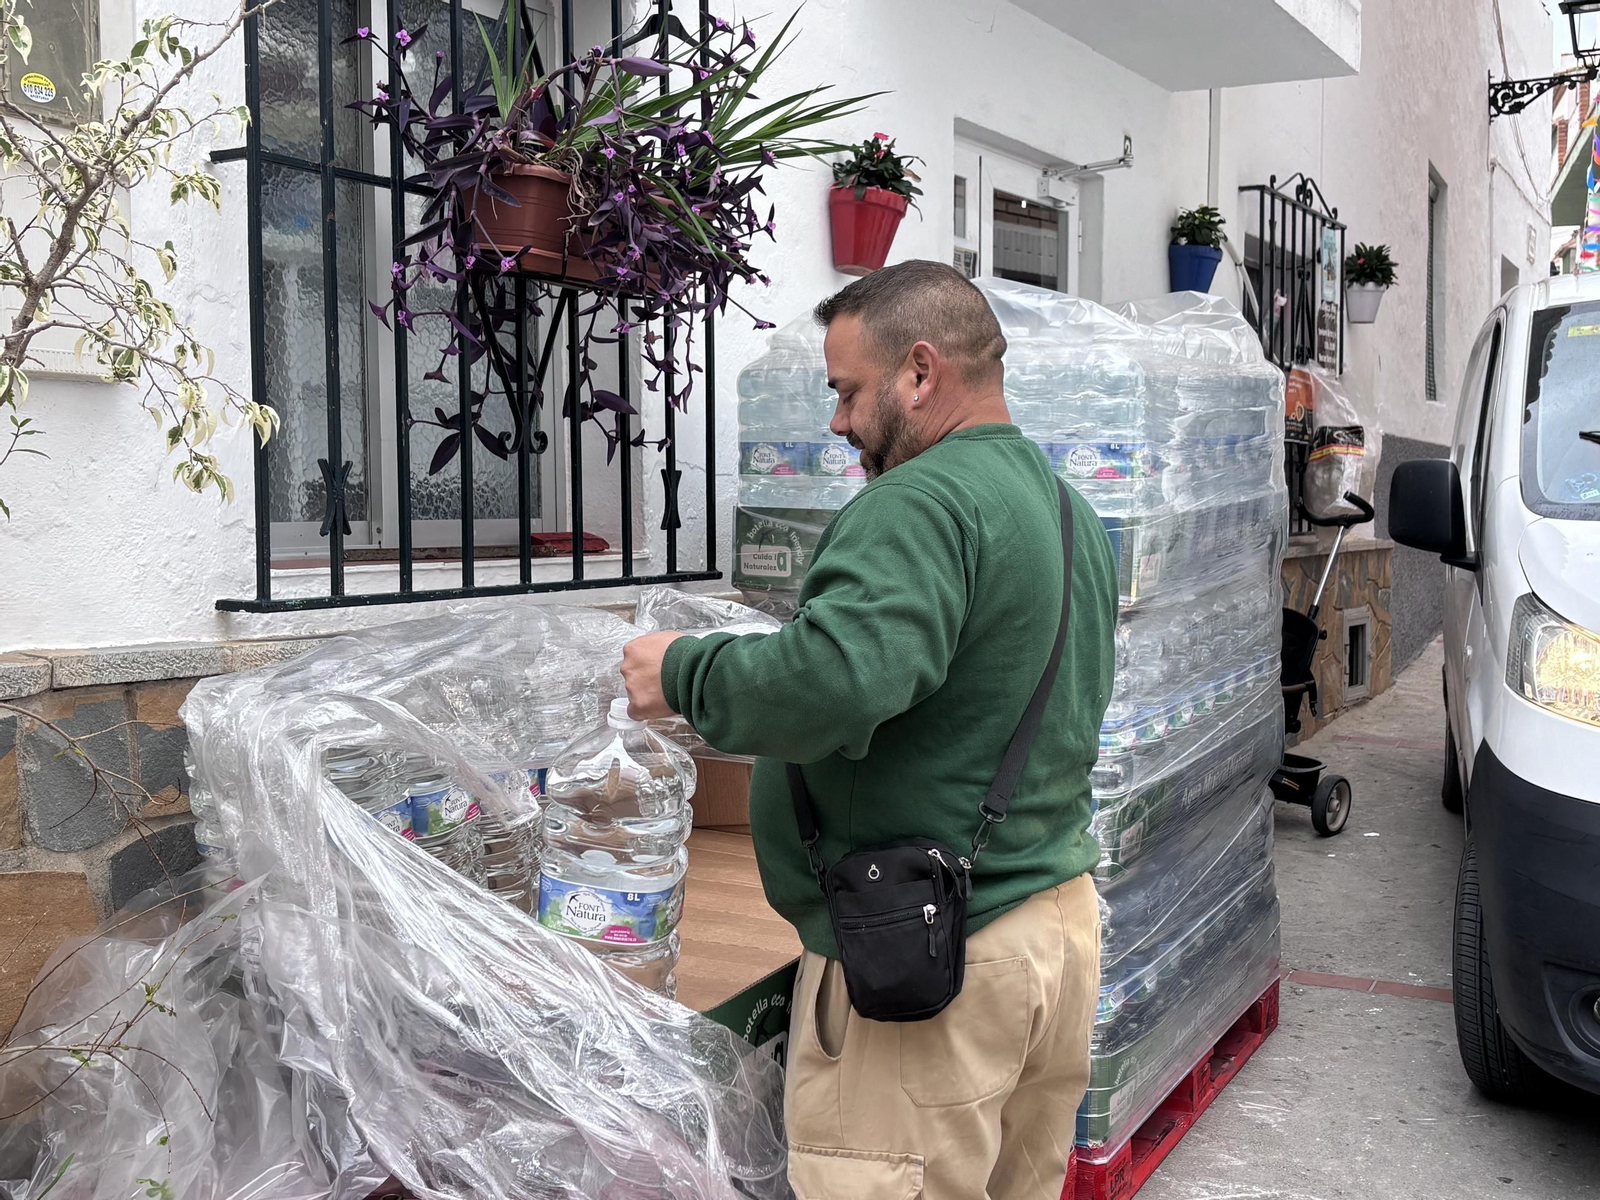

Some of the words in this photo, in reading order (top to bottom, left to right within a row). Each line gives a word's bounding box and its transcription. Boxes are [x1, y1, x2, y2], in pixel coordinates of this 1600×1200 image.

[822, 457, 846, 465] Natura
[1069, 458, 1098, 467] Natura
[746, 519, 773, 539] botella
[790, 531, 805, 565] friendly
[752, 553, 772, 561] Cuida
[445, 800, 468, 816] Natura
[627, 893, 641, 902] 8L
[578, 902, 600, 912] FONT
[566, 904, 606, 922] Natura
[1110, 1169, 1124, 1193] LPR
